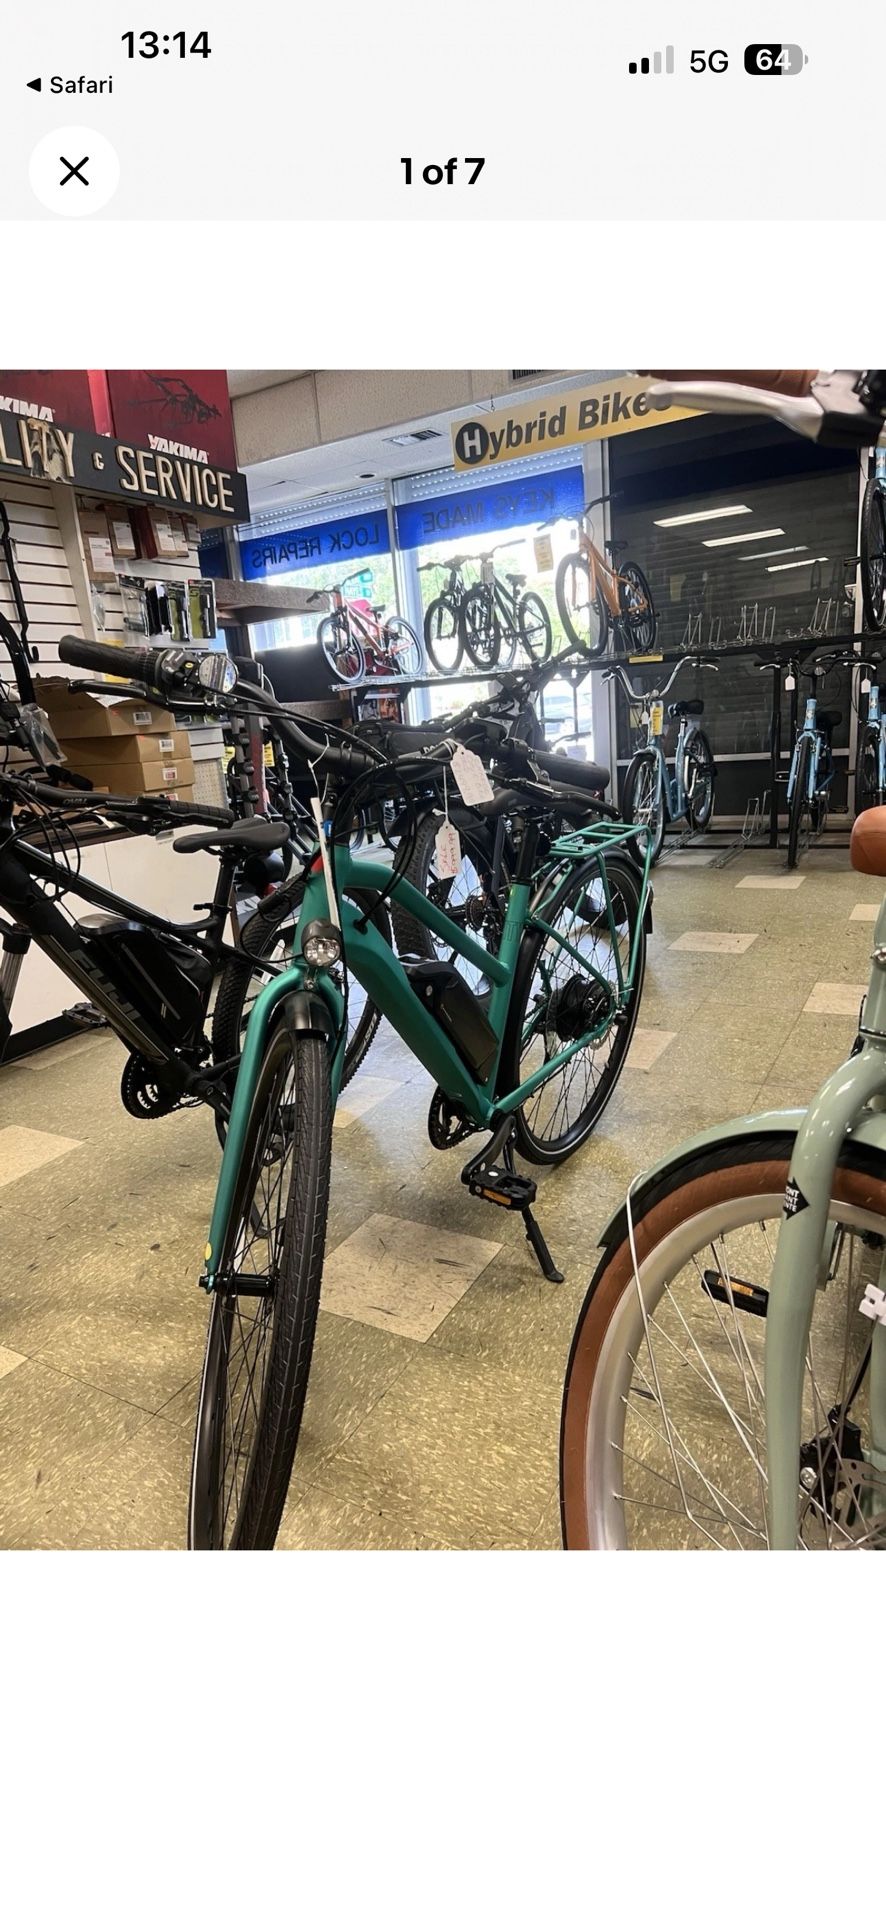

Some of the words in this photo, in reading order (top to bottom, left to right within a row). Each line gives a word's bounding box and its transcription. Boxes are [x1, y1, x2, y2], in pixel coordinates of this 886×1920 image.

[148, 433, 208, 464] YAKIMA
[456, 406, 567, 464] Hybrid
[116, 445, 235, 512] SERVICE
[69, 949, 141, 1020] FUJI
